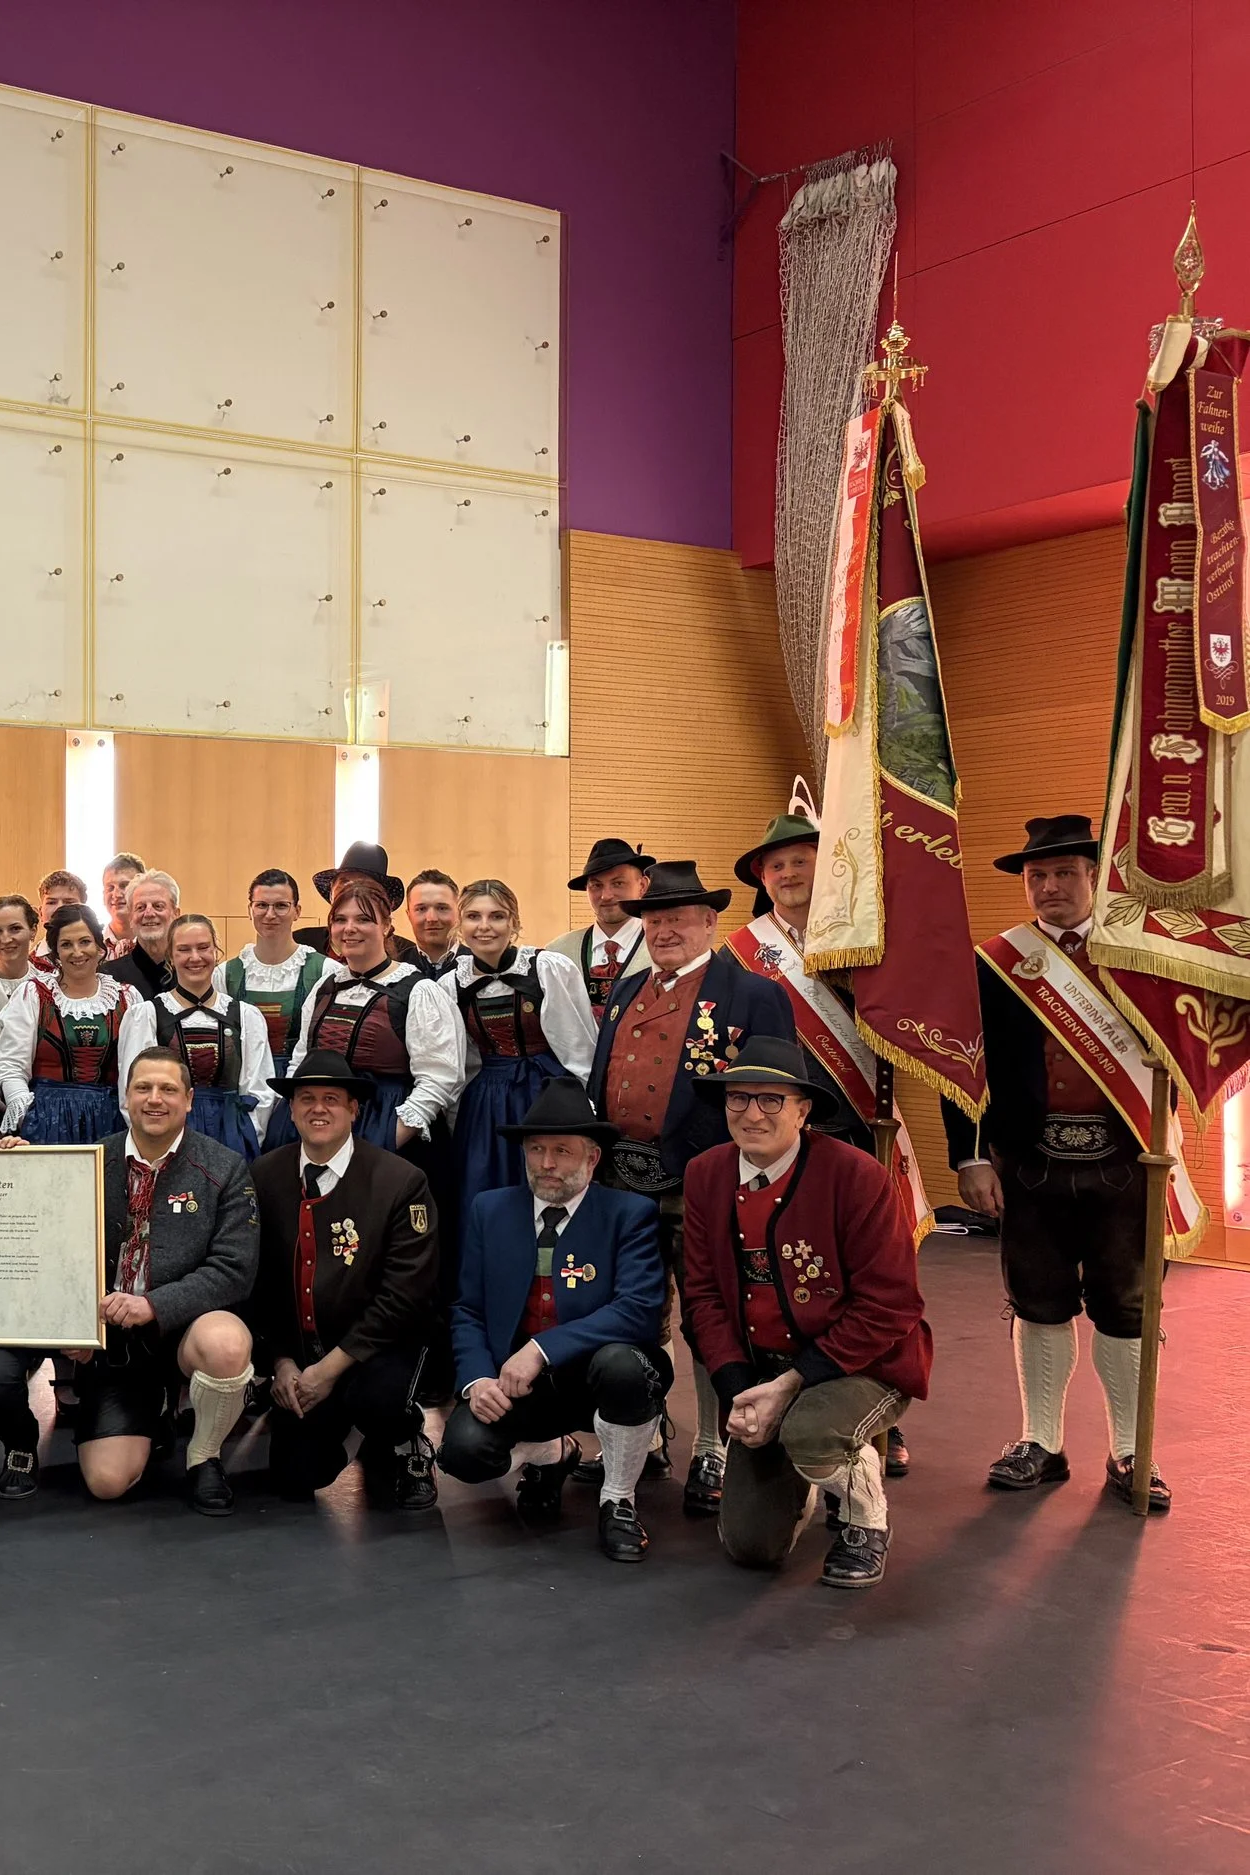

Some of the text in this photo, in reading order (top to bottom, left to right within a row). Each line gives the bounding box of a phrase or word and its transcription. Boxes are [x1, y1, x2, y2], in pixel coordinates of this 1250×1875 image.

[1206, 385, 1224, 400] Zur
[1196, 401, 1232, 419] Fahnen-
[1200, 420, 1225, 435] weihe
[1154, 538, 1197, 612] Maria
[1206, 551, 1236, 584] verband
[1206, 571, 1235, 603] Osttirol
[1152, 621, 1200, 762] Fahnenmutter
[1215, 694, 1235, 706] 2019
[1035, 985, 1117, 1075] TRACHTENVERBAND
[1062, 981, 1129, 1056] UNTERINNTALER
